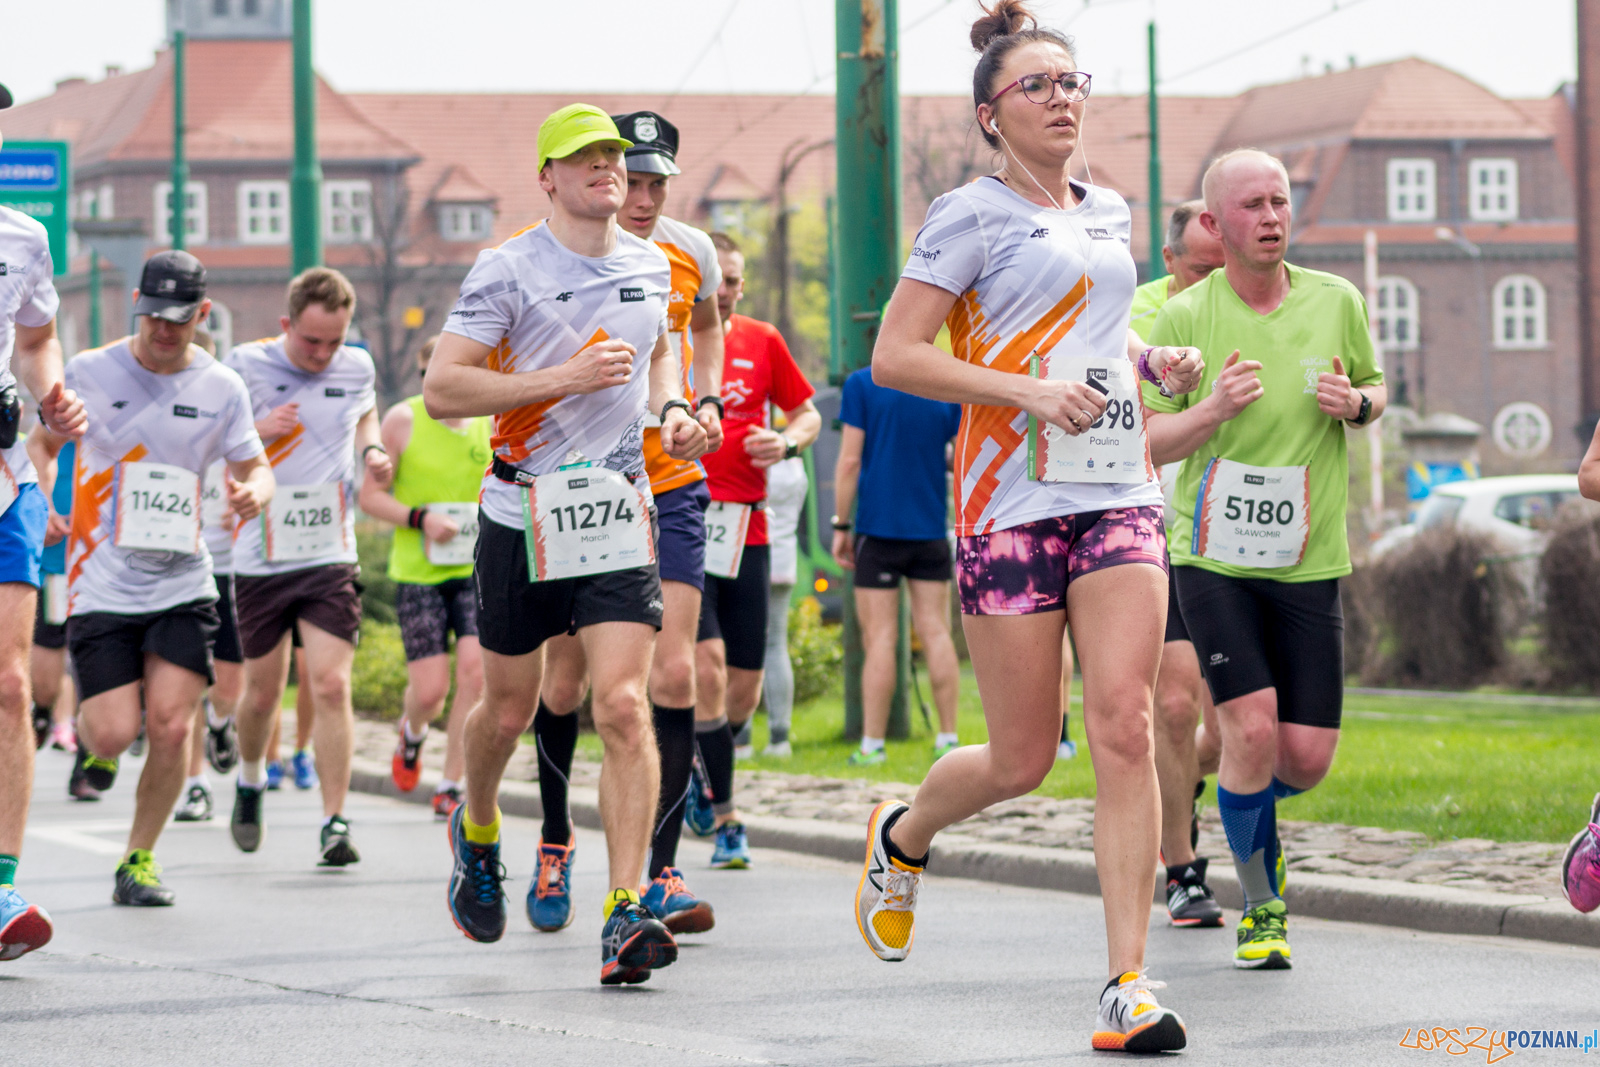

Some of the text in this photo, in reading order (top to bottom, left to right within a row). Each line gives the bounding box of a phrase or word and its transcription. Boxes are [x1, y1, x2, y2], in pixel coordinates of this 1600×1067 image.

[1030, 228, 1049, 238] 4F
[556, 292, 574, 302] 4F
[1089, 436, 1120, 446] Paulina
[132, 490, 192, 517] 11426
[550, 498, 635, 533] 11274
[1224, 495, 1294, 525] 5180
[283, 507, 332, 527] 4128
[581, 533, 610, 543] Marcin
[1234, 527, 1281, 538] SŁAWOMIR
